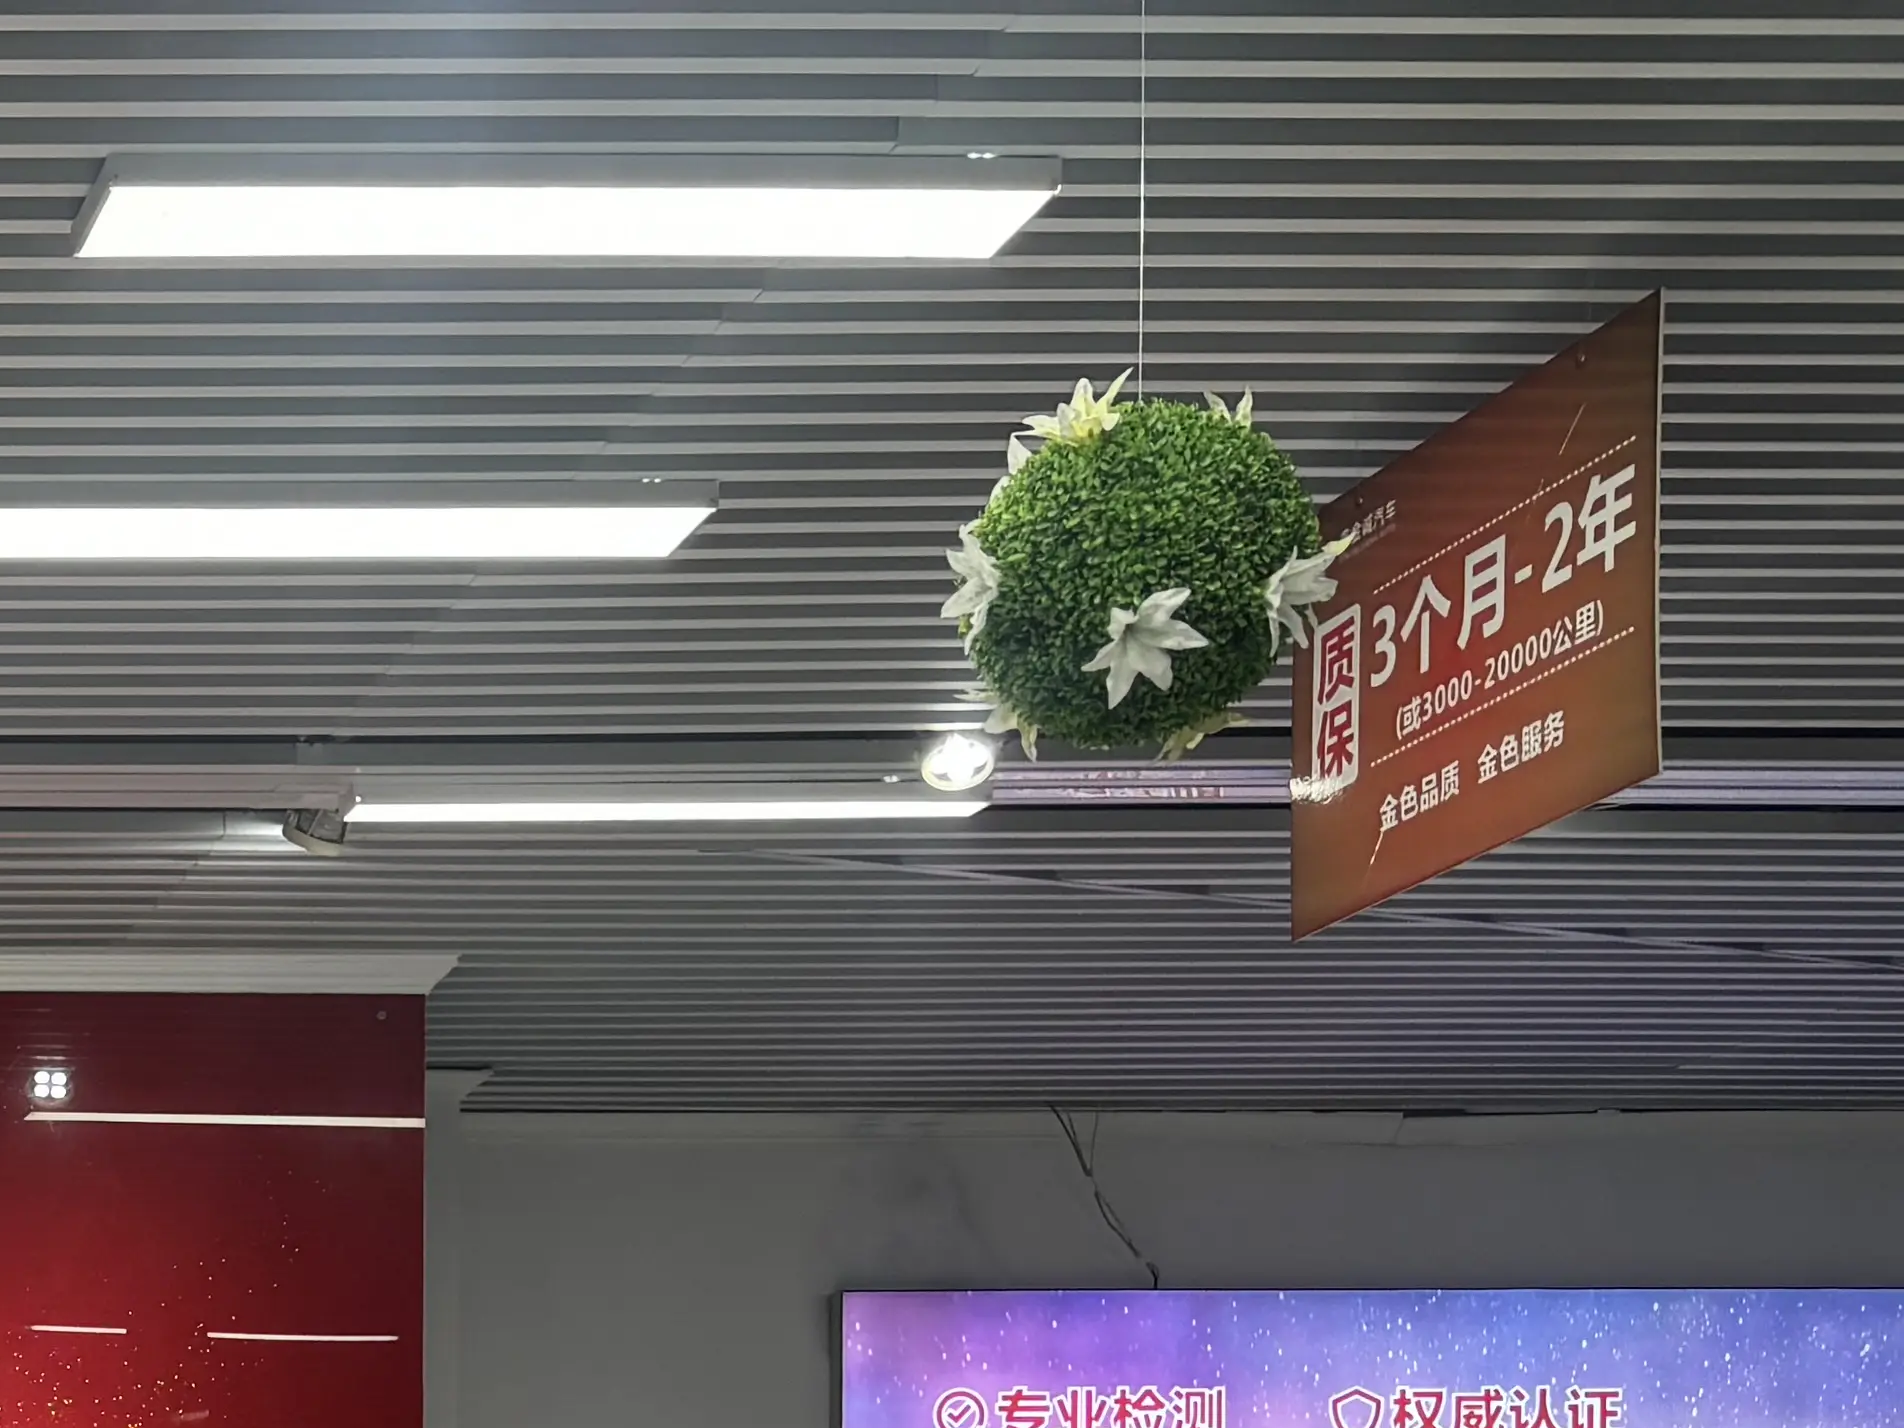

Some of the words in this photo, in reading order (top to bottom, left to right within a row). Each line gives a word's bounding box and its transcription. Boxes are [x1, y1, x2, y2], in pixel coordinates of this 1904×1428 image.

[1341, 499, 1397, 545] 金诚汽车
[1370, 464, 1637, 690] 3个月-2年
[1316, 617, 1358, 778] 质保
[1395, 600, 1604, 741] (或3000-20000公里)
[1379, 761, 1461, 833] 金色品质
[1477, 711, 1566, 785] 金色服务
